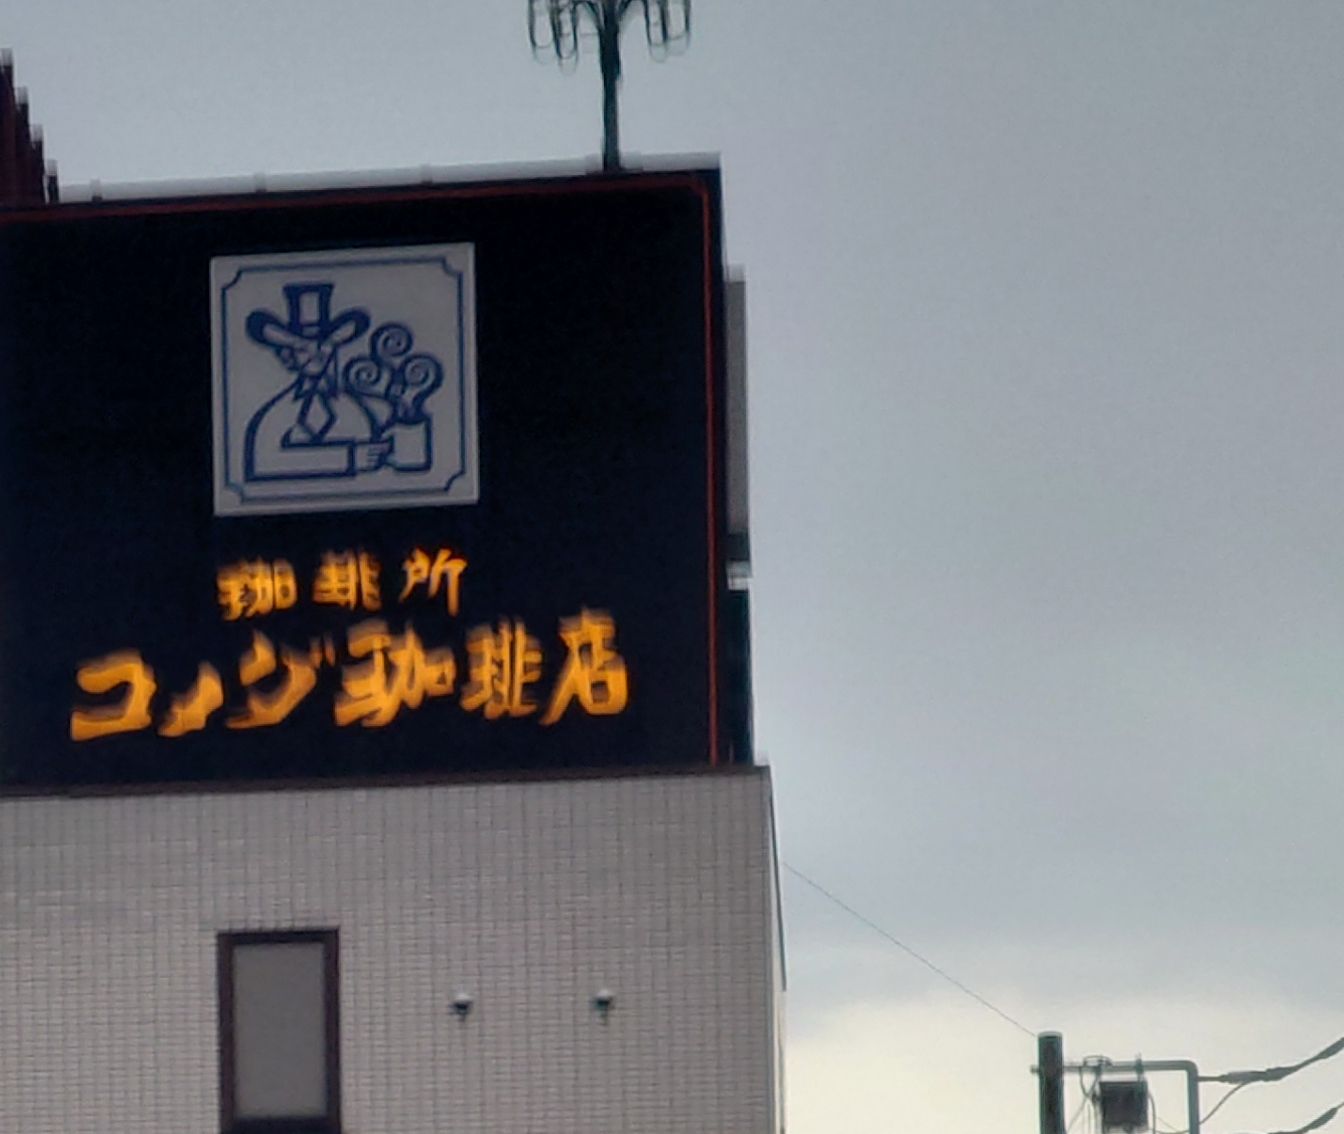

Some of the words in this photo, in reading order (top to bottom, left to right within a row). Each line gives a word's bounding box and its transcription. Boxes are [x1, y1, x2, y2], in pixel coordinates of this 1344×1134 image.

[70, 607, 629, 740] コメダ珈琲店
